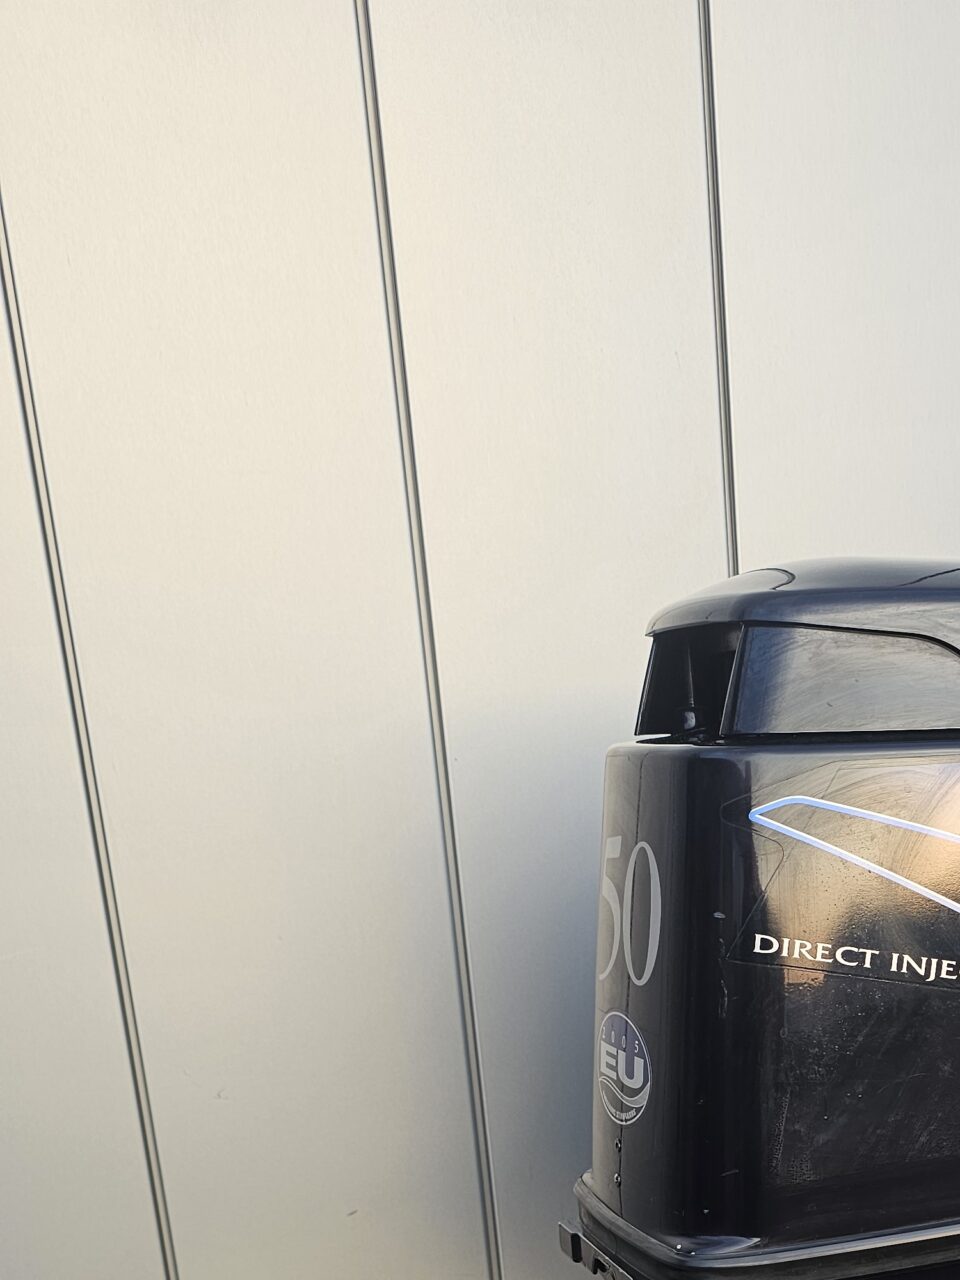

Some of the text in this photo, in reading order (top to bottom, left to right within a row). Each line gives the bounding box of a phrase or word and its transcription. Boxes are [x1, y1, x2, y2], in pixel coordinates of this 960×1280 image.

[599, 836, 661, 986] 50
[753, 933, 879, 968] DIRECT
[600, 1040, 644, 1089] EU
